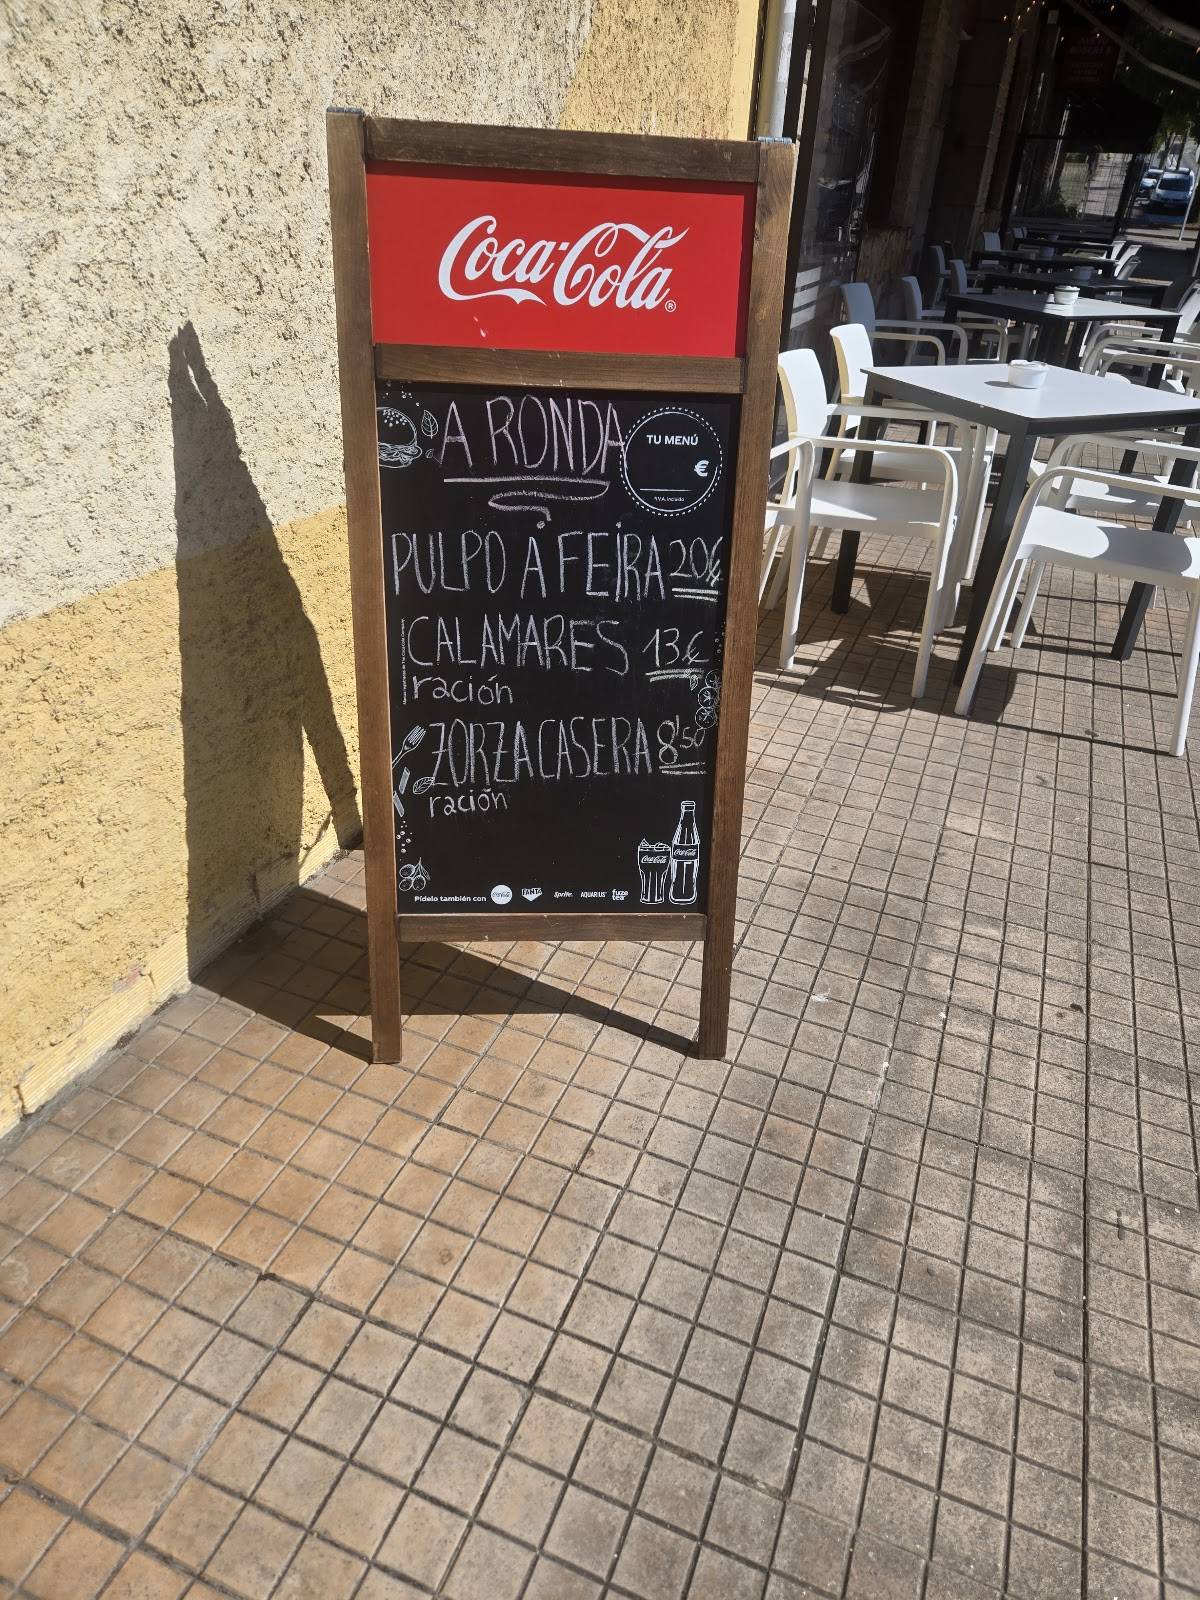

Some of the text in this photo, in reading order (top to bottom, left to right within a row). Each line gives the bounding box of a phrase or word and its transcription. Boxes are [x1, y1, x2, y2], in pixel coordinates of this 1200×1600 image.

[438, 214, 690, 310] Coca-Cola
[439, 394, 627, 476] A RONDA
[646, 433, 699, 446] TU MENÚ
[391, 529, 507, 596] PULPO
[407, 613, 630, 676] CALAMARES
[412, 674, 514, 705] ración
[428, 718, 535, 788] ZORZA
[538, 716, 653, 781] CASERA
[428, 787, 509, 818] ración
[414, 895, 439, 903] Pídelo
